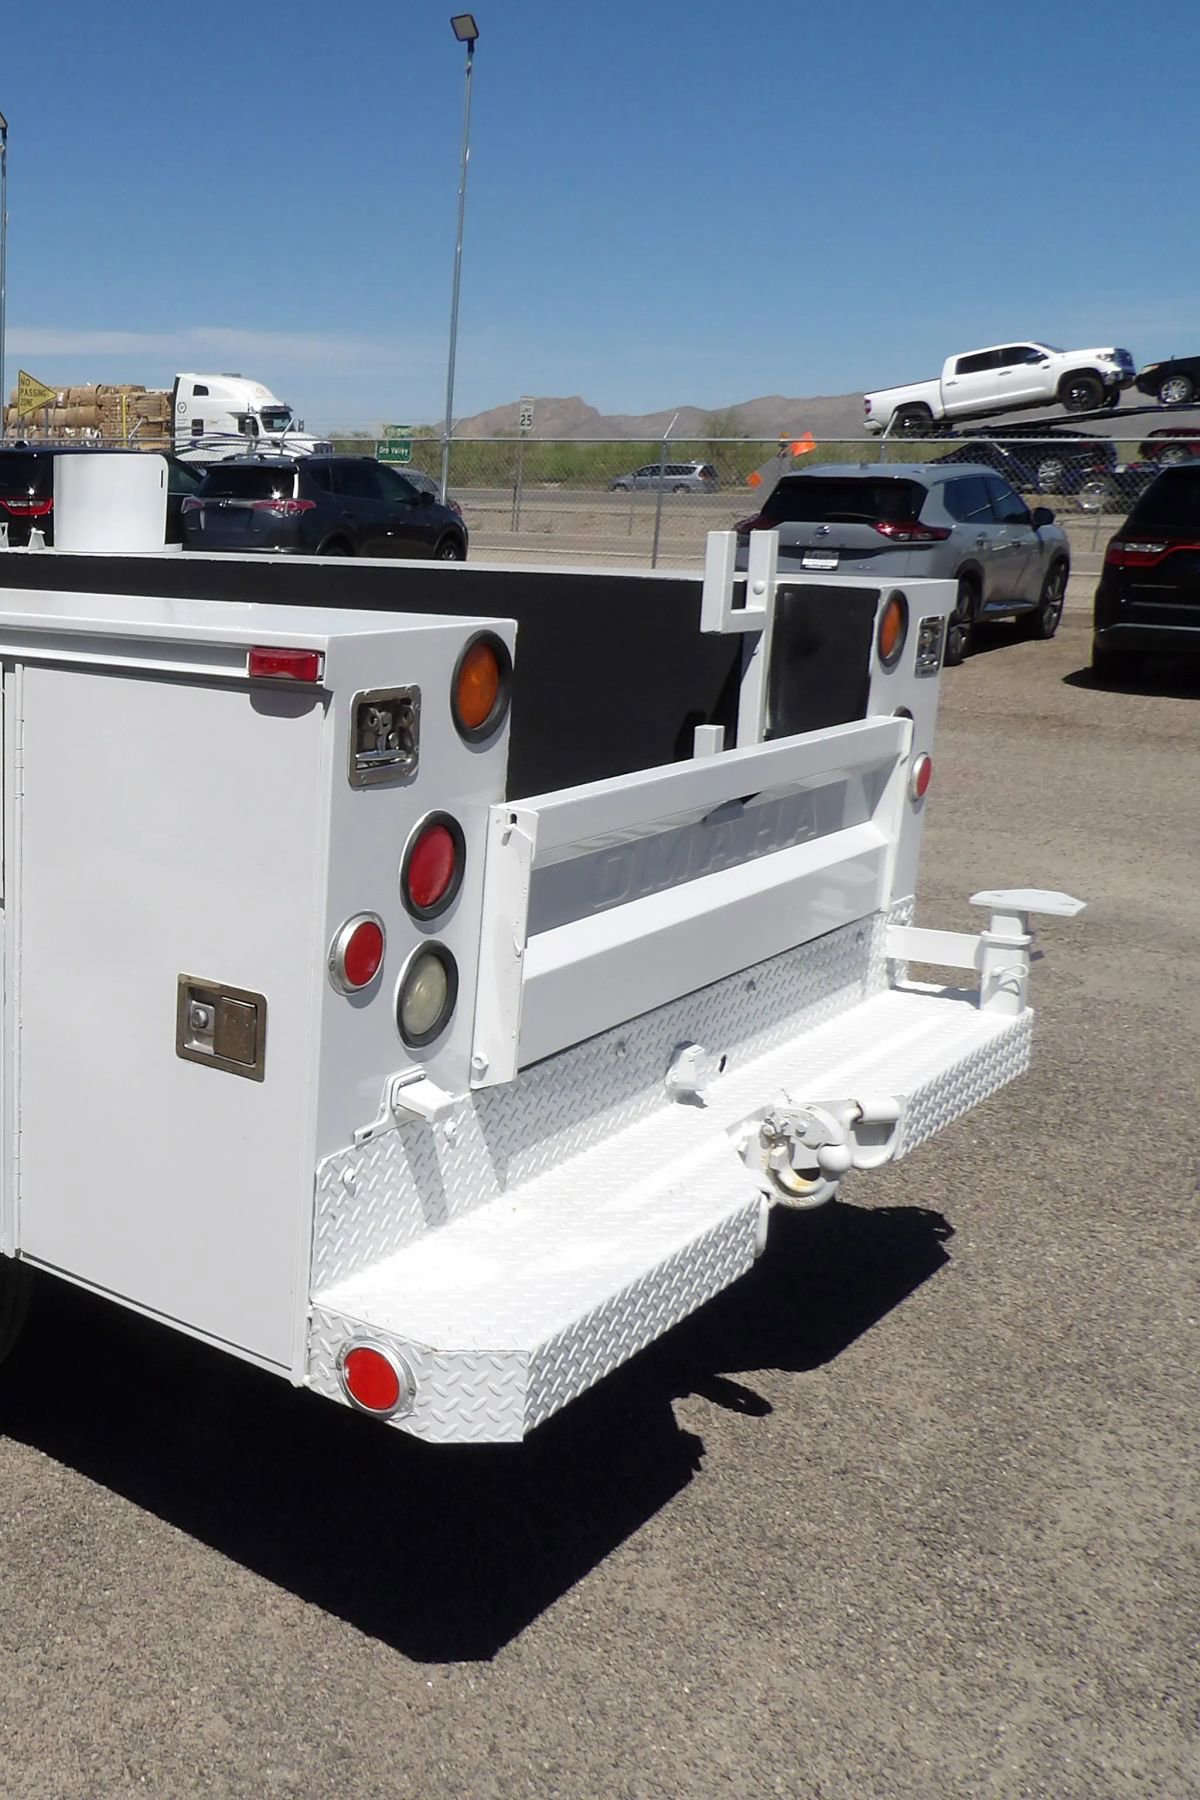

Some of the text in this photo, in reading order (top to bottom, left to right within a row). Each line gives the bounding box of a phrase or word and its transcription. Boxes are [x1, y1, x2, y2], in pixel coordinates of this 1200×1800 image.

[20, 377, 30, 387] NO
[20, 388, 48, 397] PASSING
[520, 414, 532, 427] 25
[590, 790, 819, 909] OMAHA
